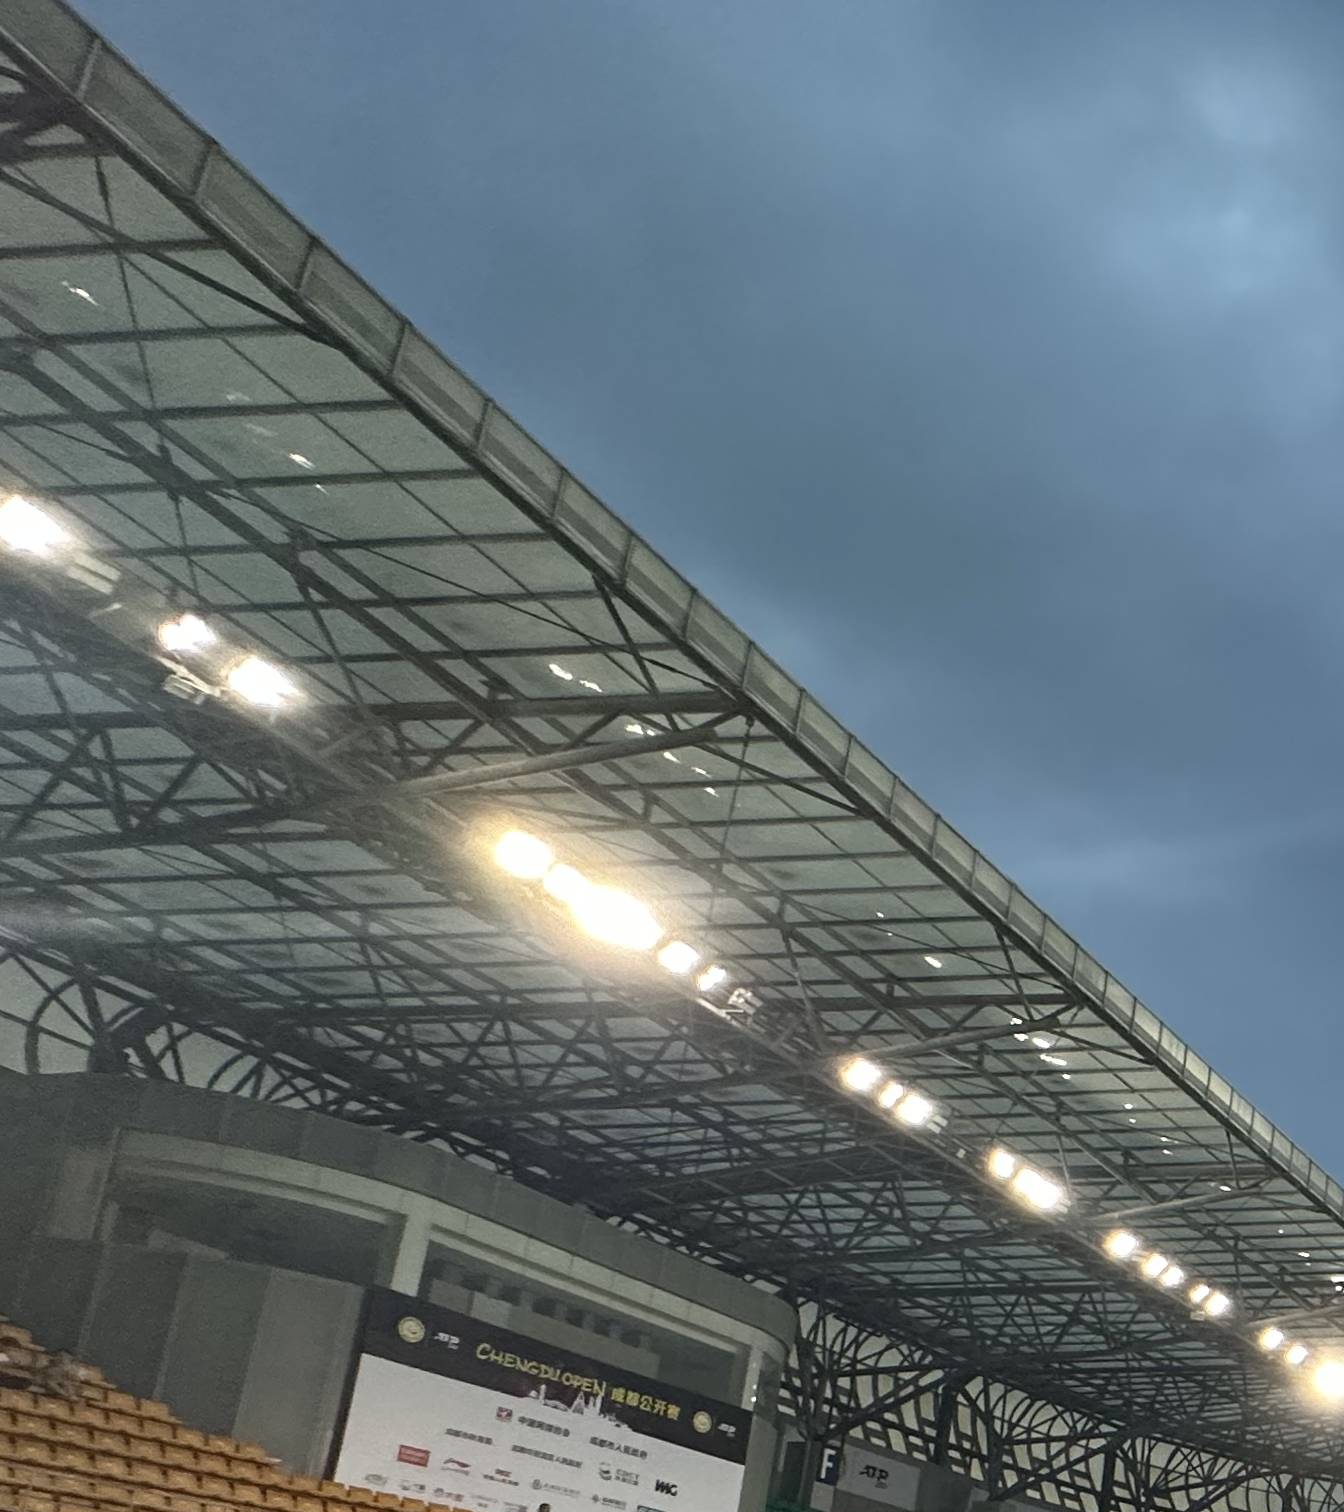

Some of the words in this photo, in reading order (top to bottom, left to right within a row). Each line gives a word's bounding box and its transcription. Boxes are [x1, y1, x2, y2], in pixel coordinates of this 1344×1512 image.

[476, 1343, 561, 1382] CHENGDU
[562, 1372, 606, 1399] OPEN
[820, 1447, 837, 1479] F
